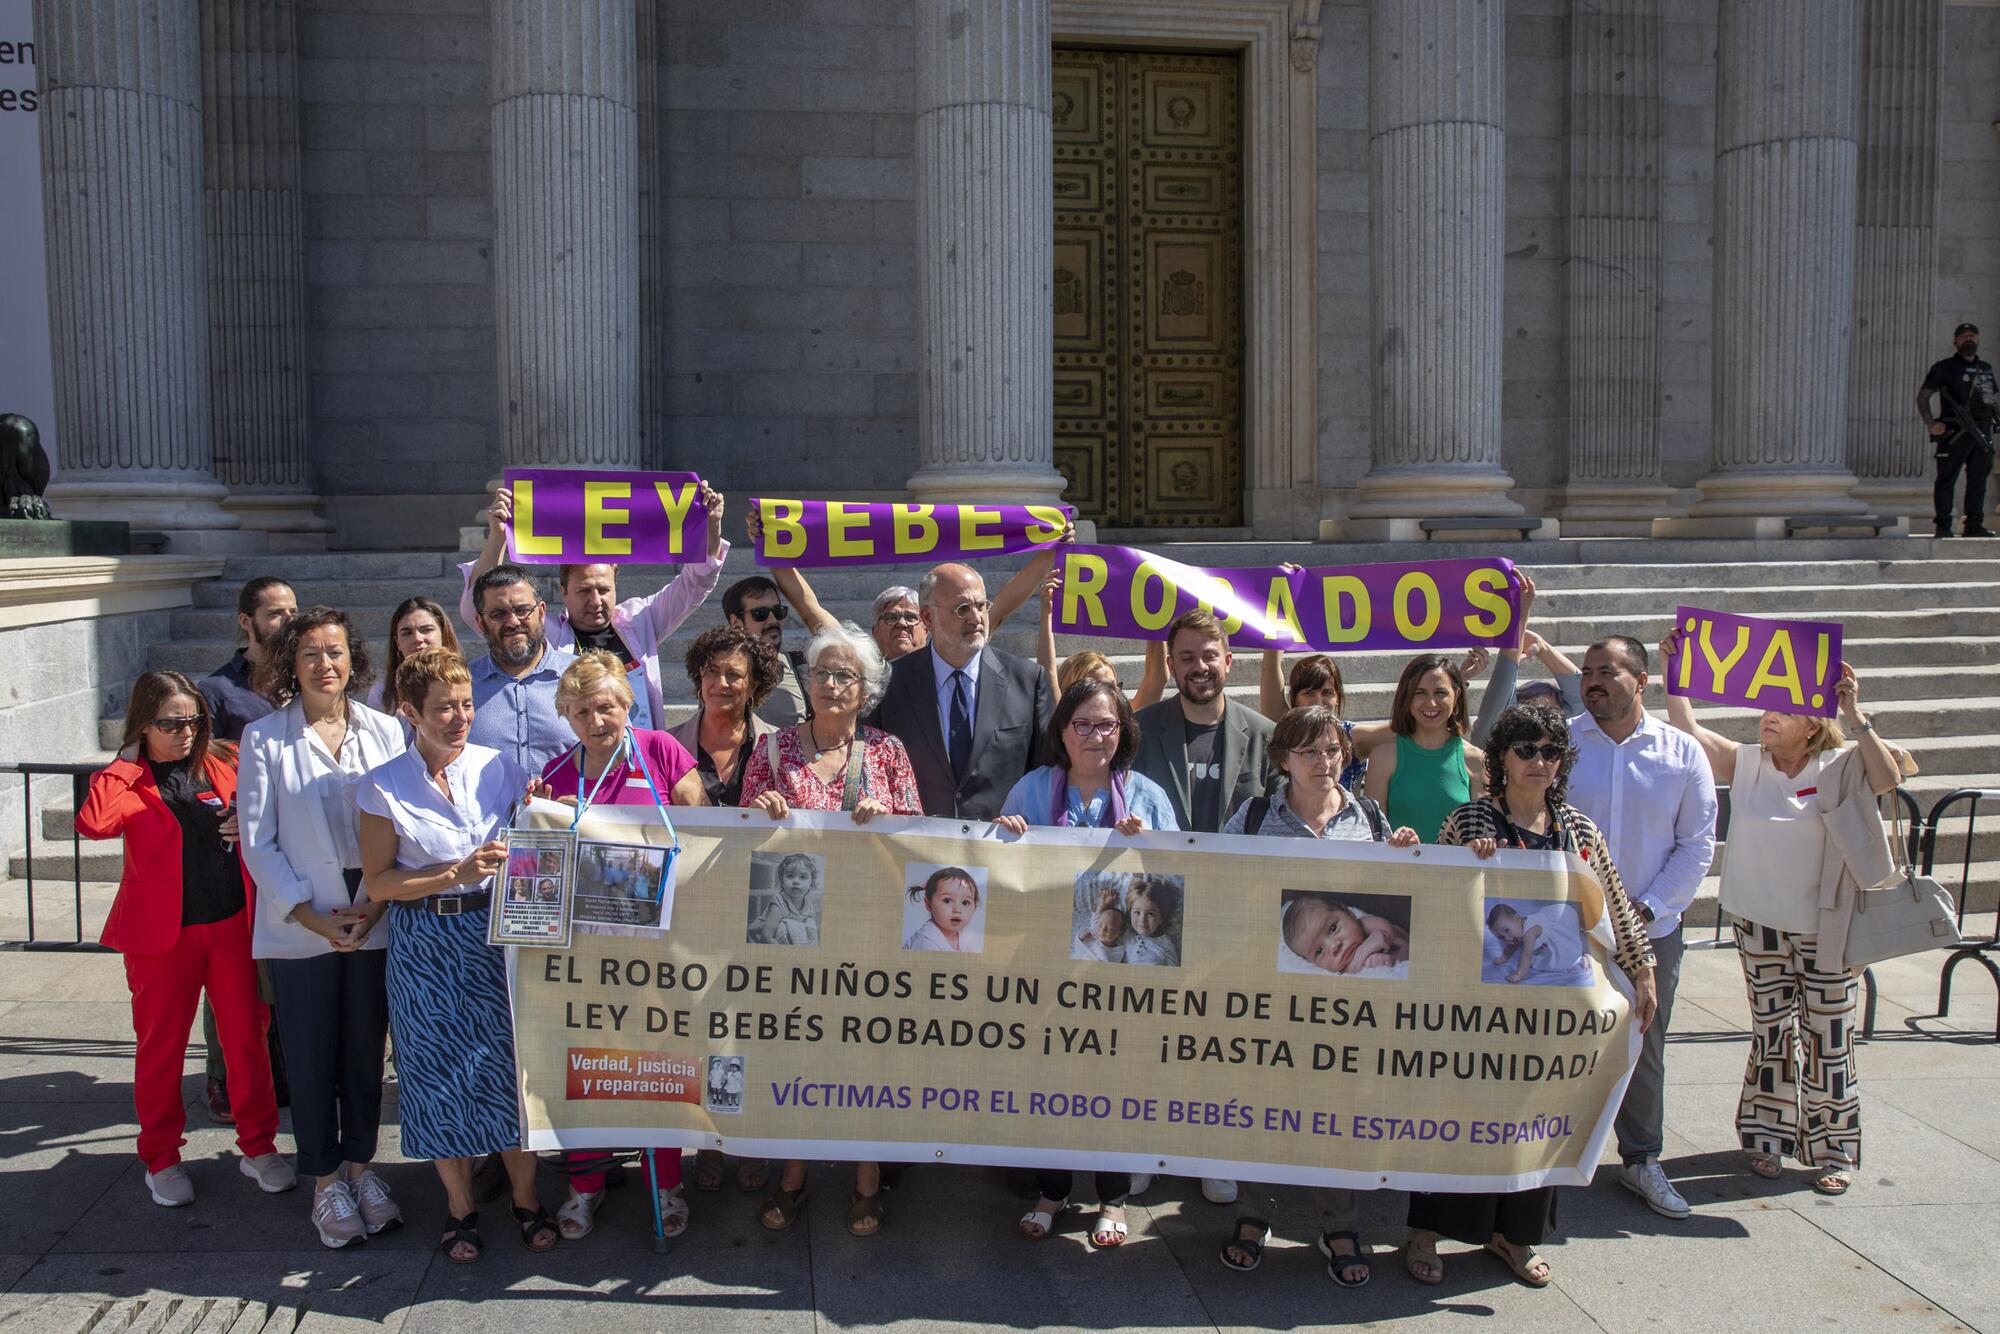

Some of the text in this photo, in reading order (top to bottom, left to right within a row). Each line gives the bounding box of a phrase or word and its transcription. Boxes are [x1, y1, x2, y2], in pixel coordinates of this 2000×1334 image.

[514, 480, 697, 554] LEY
[760, 498, 1067, 559] BEBES
[1062, 554, 1510, 641] ROBADOS
[1679, 619, 1828, 707] ¡YA!
[545, 954, 1616, 1035] EL ROBO DE NIÑOS ES UN CRIMEN DE LESA HUMANIDAD
[566, 1002, 1117, 1056] LEY DE BEBÉS ROBADOS ¡YA!
[1161, 1035, 1598, 1081] ¡BASTA DE IMPUNIDAD!
[571, 1055, 696, 1077] Verdad, justicia
[582, 1077, 685, 1096] y reparación
[772, 1078, 1573, 1145] VÍCTIMAS POR EL ROBO DE BEBÉS EN EL ESTADO ESPAÑOL
